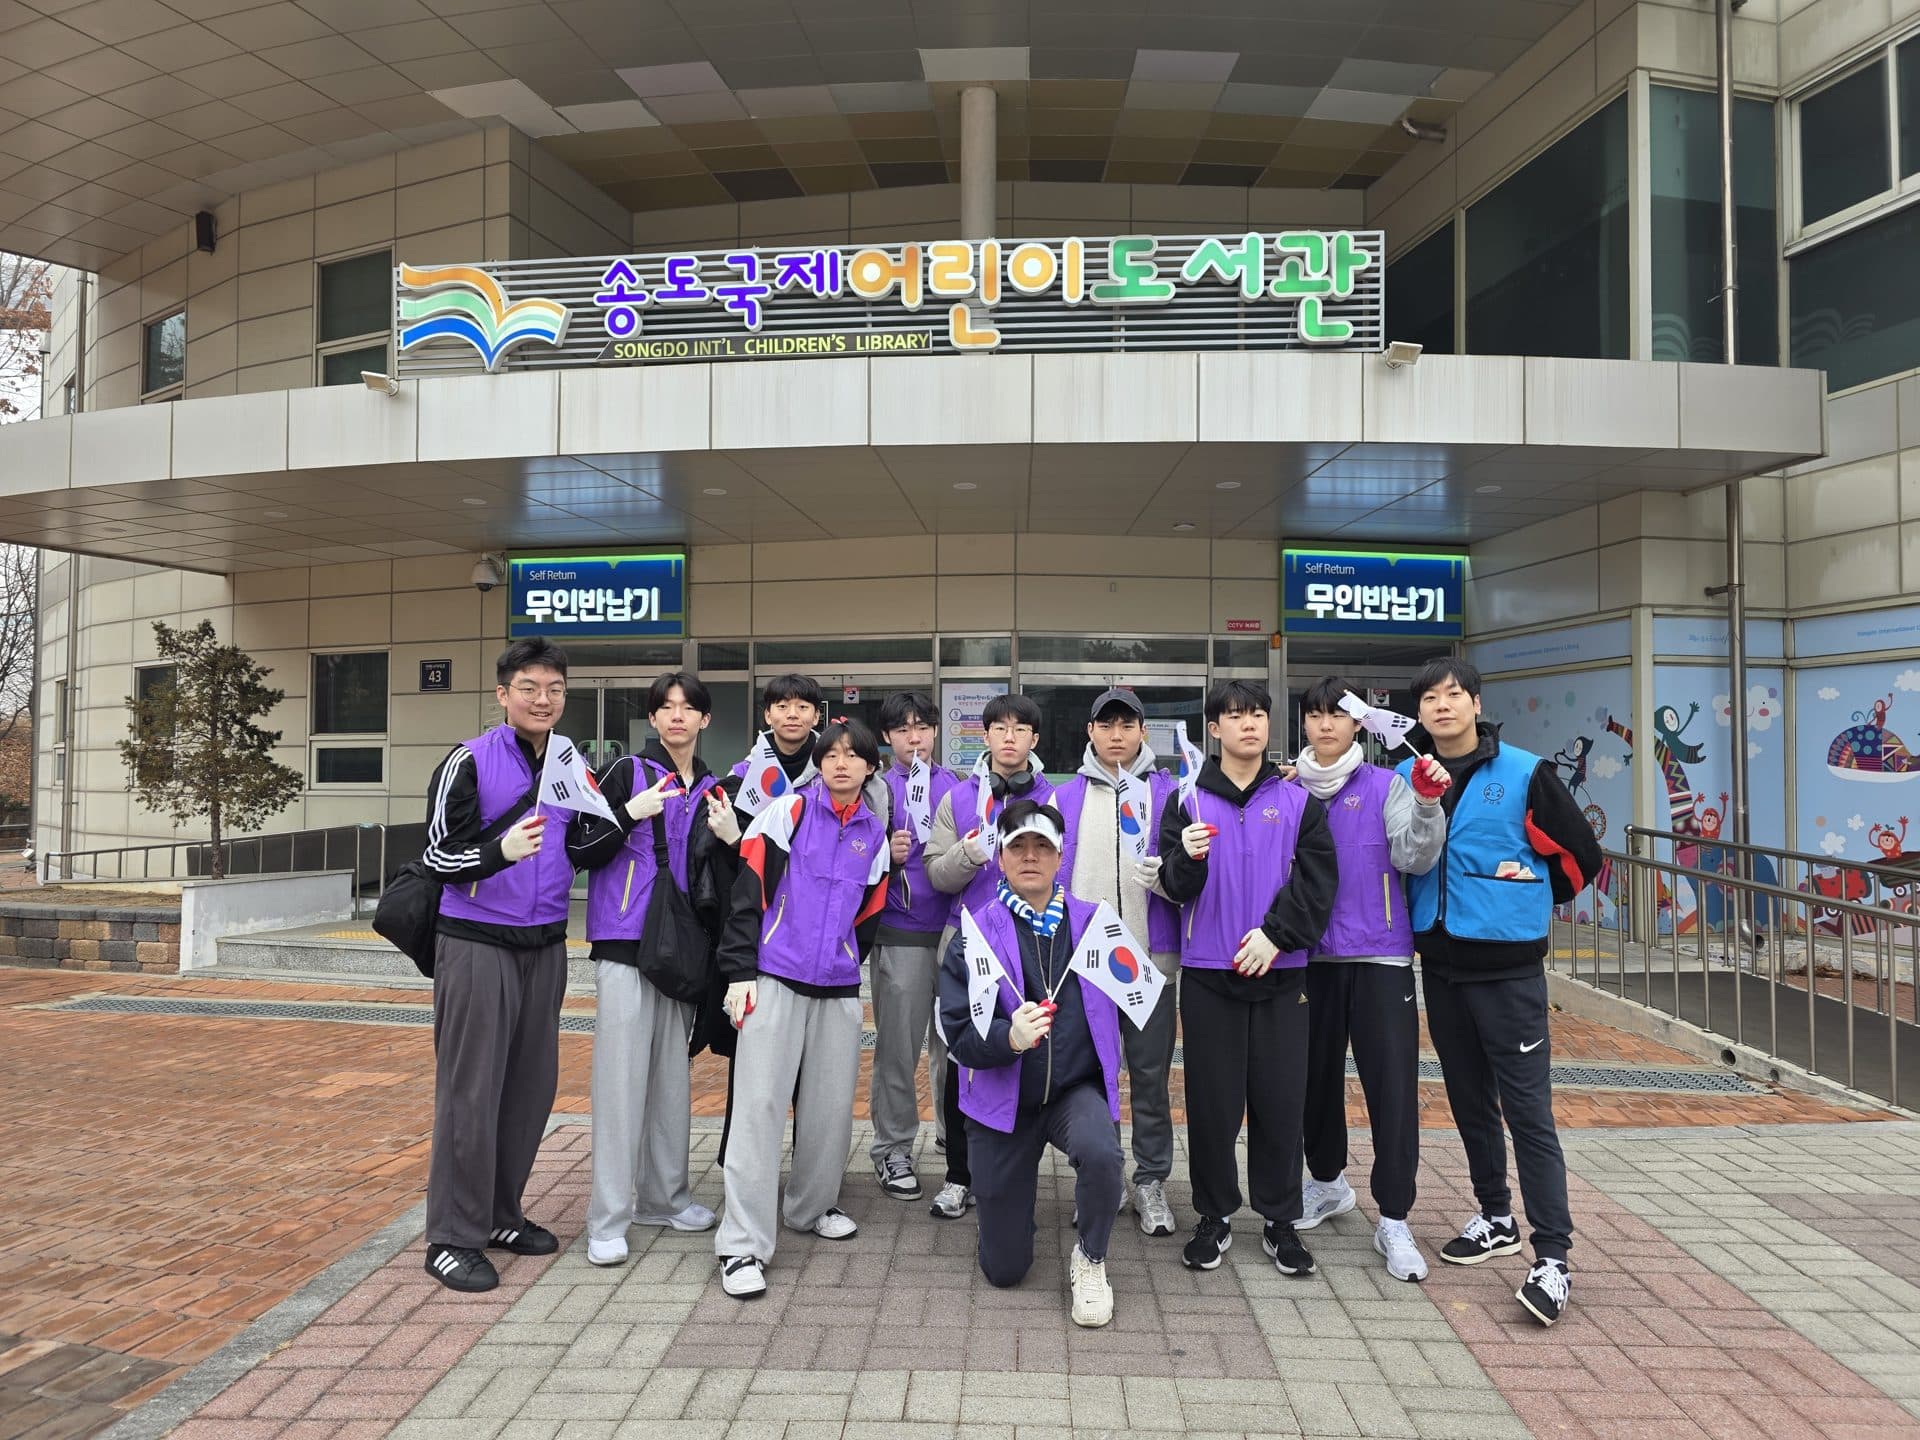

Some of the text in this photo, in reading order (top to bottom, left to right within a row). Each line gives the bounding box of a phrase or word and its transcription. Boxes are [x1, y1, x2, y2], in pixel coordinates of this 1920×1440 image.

[593, 231, 1371, 351] 송도국제어린이도서관
[614, 333, 929, 359] SONGDO INT'L CHILDREN'S LIBRARY
[529, 570, 577, 580] Self Return
[1305, 562, 1355, 575] Self Return
[525, 587, 659, 624] 무인반납기
[1304, 583, 1445, 622] 무인반납기
[428, 670, 442, 683] 43
